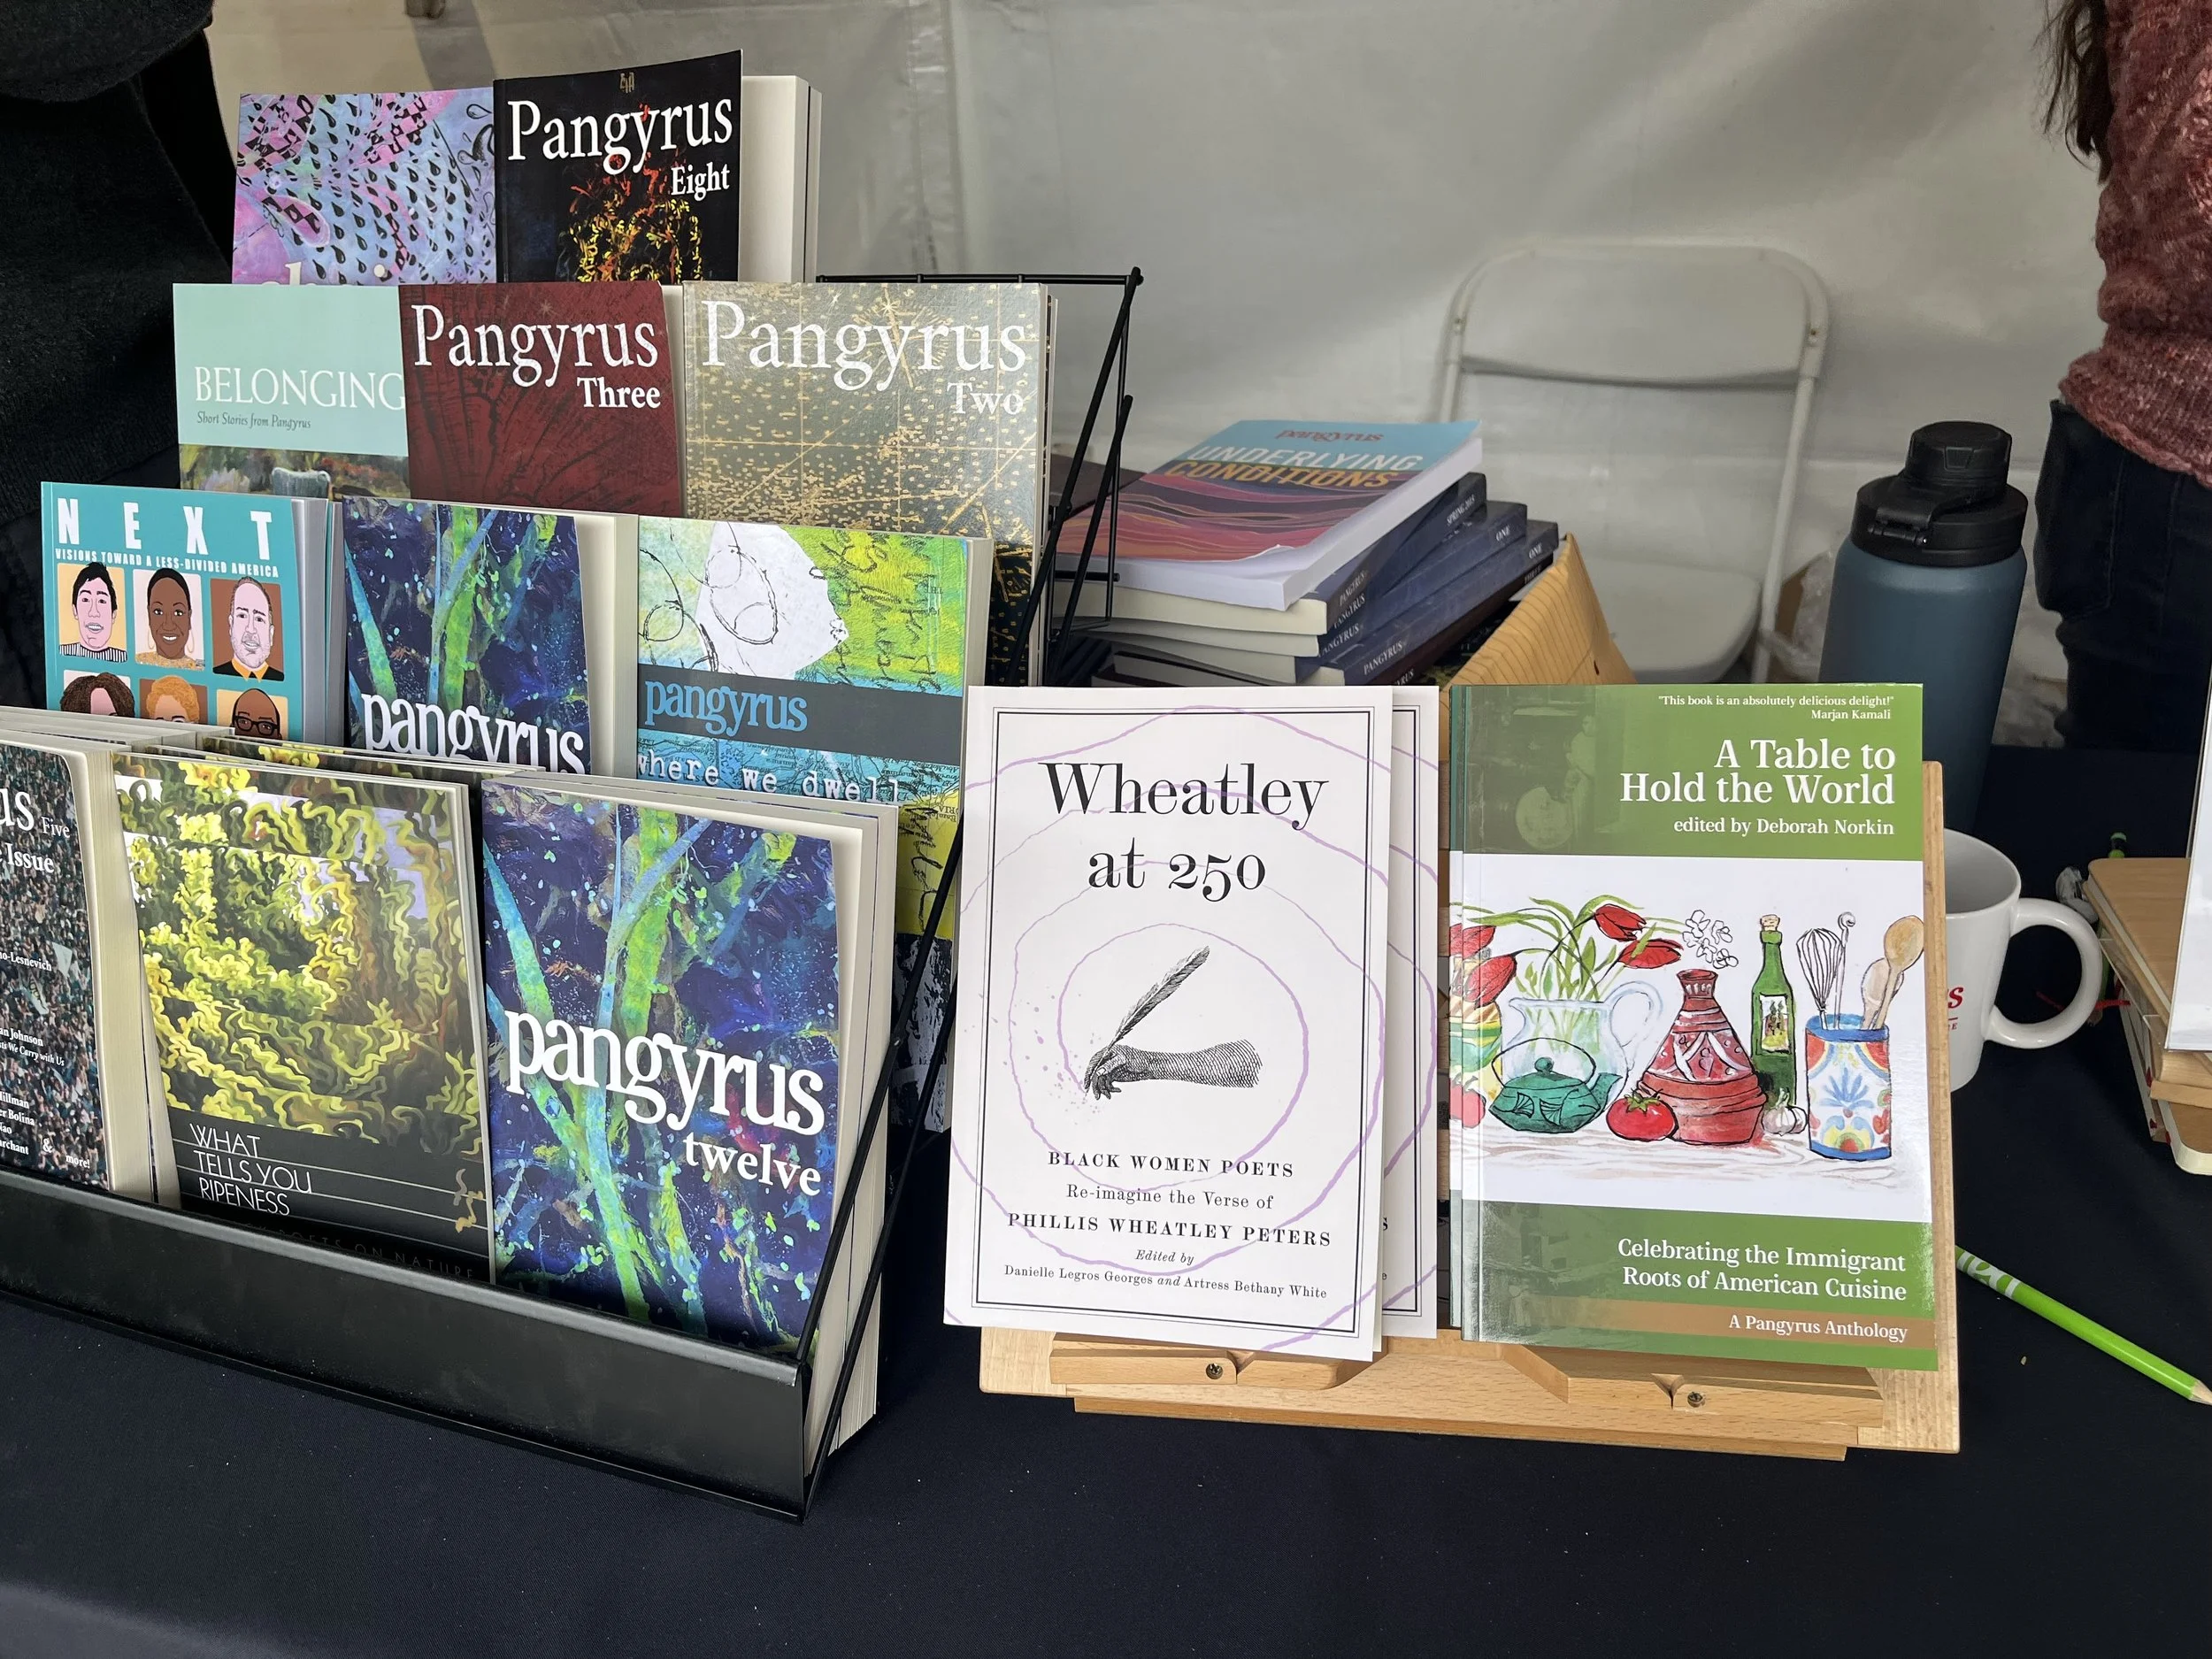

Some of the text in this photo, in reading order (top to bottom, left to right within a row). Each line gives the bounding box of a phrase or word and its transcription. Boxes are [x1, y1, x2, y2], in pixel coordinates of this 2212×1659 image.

[507, 99, 733, 174] Pangyrus
[671, 162, 730, 201] Eight
[411, 304, 658, 388] Pangyrus
[701, 300, 1026, 391] Pangyrus
[195, 366, 405, 410] BELONGING
[576, 377, 661, 408] Three
[947, 382, 1025, 415] Two
[197, 411, 311, 430] Short Stories from Pangyrus
[1275, 429, 1385, 442] pangyrus
[1187, 446, 1423, 471] UNDERLYING
[1164, 462, 1397, 488] CONDITIONS
[55, 548, 279, 578] VISIONS TOWARD A LESS-DIVIDED AMERICA
[1363, 641, 1402, 675] PANGYRUS
[645, 680, 808, 737] pangyrus
[1687, 695, 1713, 706] book
[1716, 695, 1724, 706] is
[1742, 695, 1796, 709] absolutely
[1799, 695, 1847, 706] delicious
[1811, 710, 1891, 722] Marjan Kamali
[1714, 738, 1895, 770] A Table to
[742, 770, 778, 794] we
[803, 772, 901, 803] dwell
[1038, 763, 1330, 831] Wheatley
[1620, 772, 1895, 804] Hold the World
[41, 816, 71, 839] Five
[1674, 817, 1894, 837] edited by Deborah Norkin
[5, 842, 54, 873] Issue
[1088, 837, 1265, 902] at 250
[10, 1028, 43, 1047] Johnson
[8, 1042, 19, 1053] We
[19, 1047, 38, 1061] Carry
[40, 1053, 55, 1064] with
[56, 1056, 65, 1066] Us
[504, 1010, 825, 1135] pangyrus
[8, 1109, 35, 1125] Bolina
[42, 1138, 52, 1153] &
[189, 1123, 260, 1158] WHAT
[65, 1156, 90, 1168] more!
[193, 1149, 311, 1194] TELLS YOU
[683, 1133, 821, 1196] twelve
[1048, 1151, 1294, 1178] BLACK WOMEN POETS
[199, 1177, 290, 1216] RIPENESS
[1066, 1184, 1274, 1210] Re-imagine the Verse of
[1008, 1212, 1331, 1247] PHILLIS WHEATLEY PETERS
[1136, 1249, 1194, 1266] Edited by
[1618, 1239, 1906, 1274] Celebrating the Immigrant
[1004, 1265, 1327, 1299] Danielle Legros Georges and Artress Bethany White
[1623, 1266, 1907, 1301] Roots of American Cuisine
[1729, 1315, 1908, 1342] A Pangyrus Anthology
